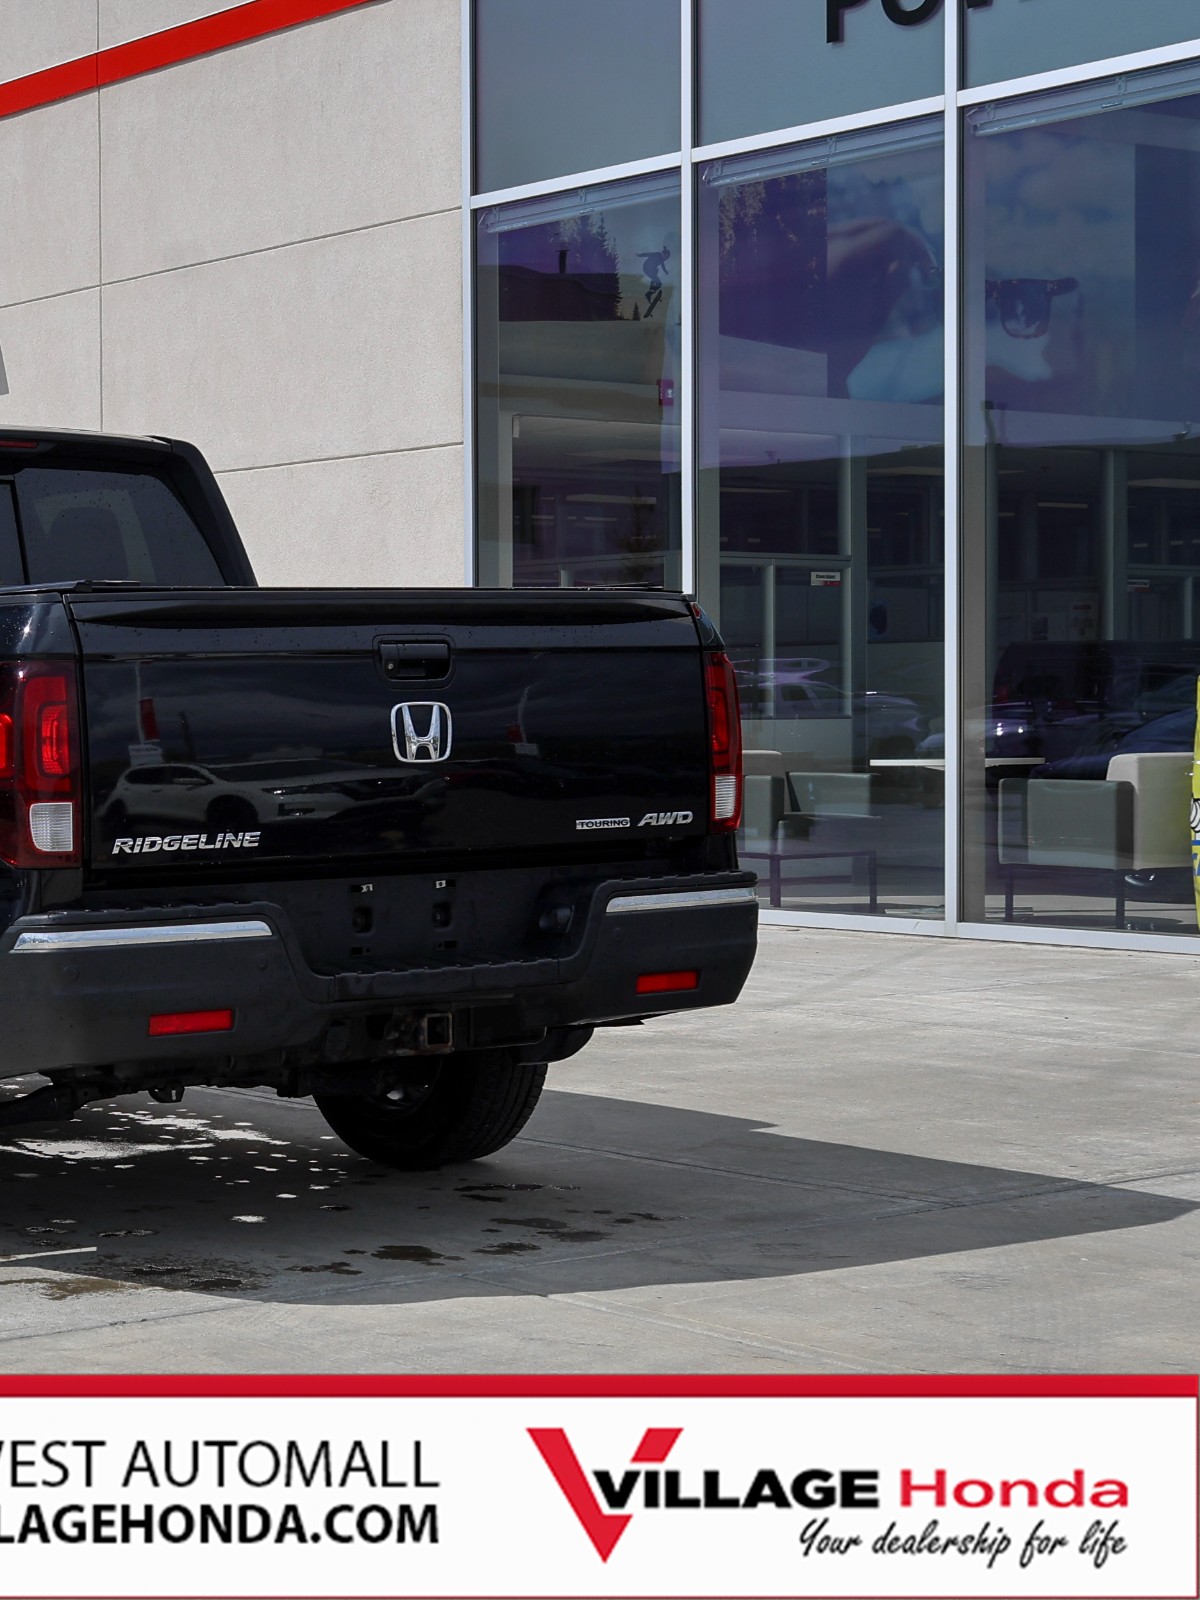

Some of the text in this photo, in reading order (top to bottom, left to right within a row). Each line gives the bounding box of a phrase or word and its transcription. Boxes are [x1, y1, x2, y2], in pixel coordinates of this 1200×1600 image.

[577, 810, 694, 829] TOURING AWD
[111, 831, 261, 855] RIDGELINE
